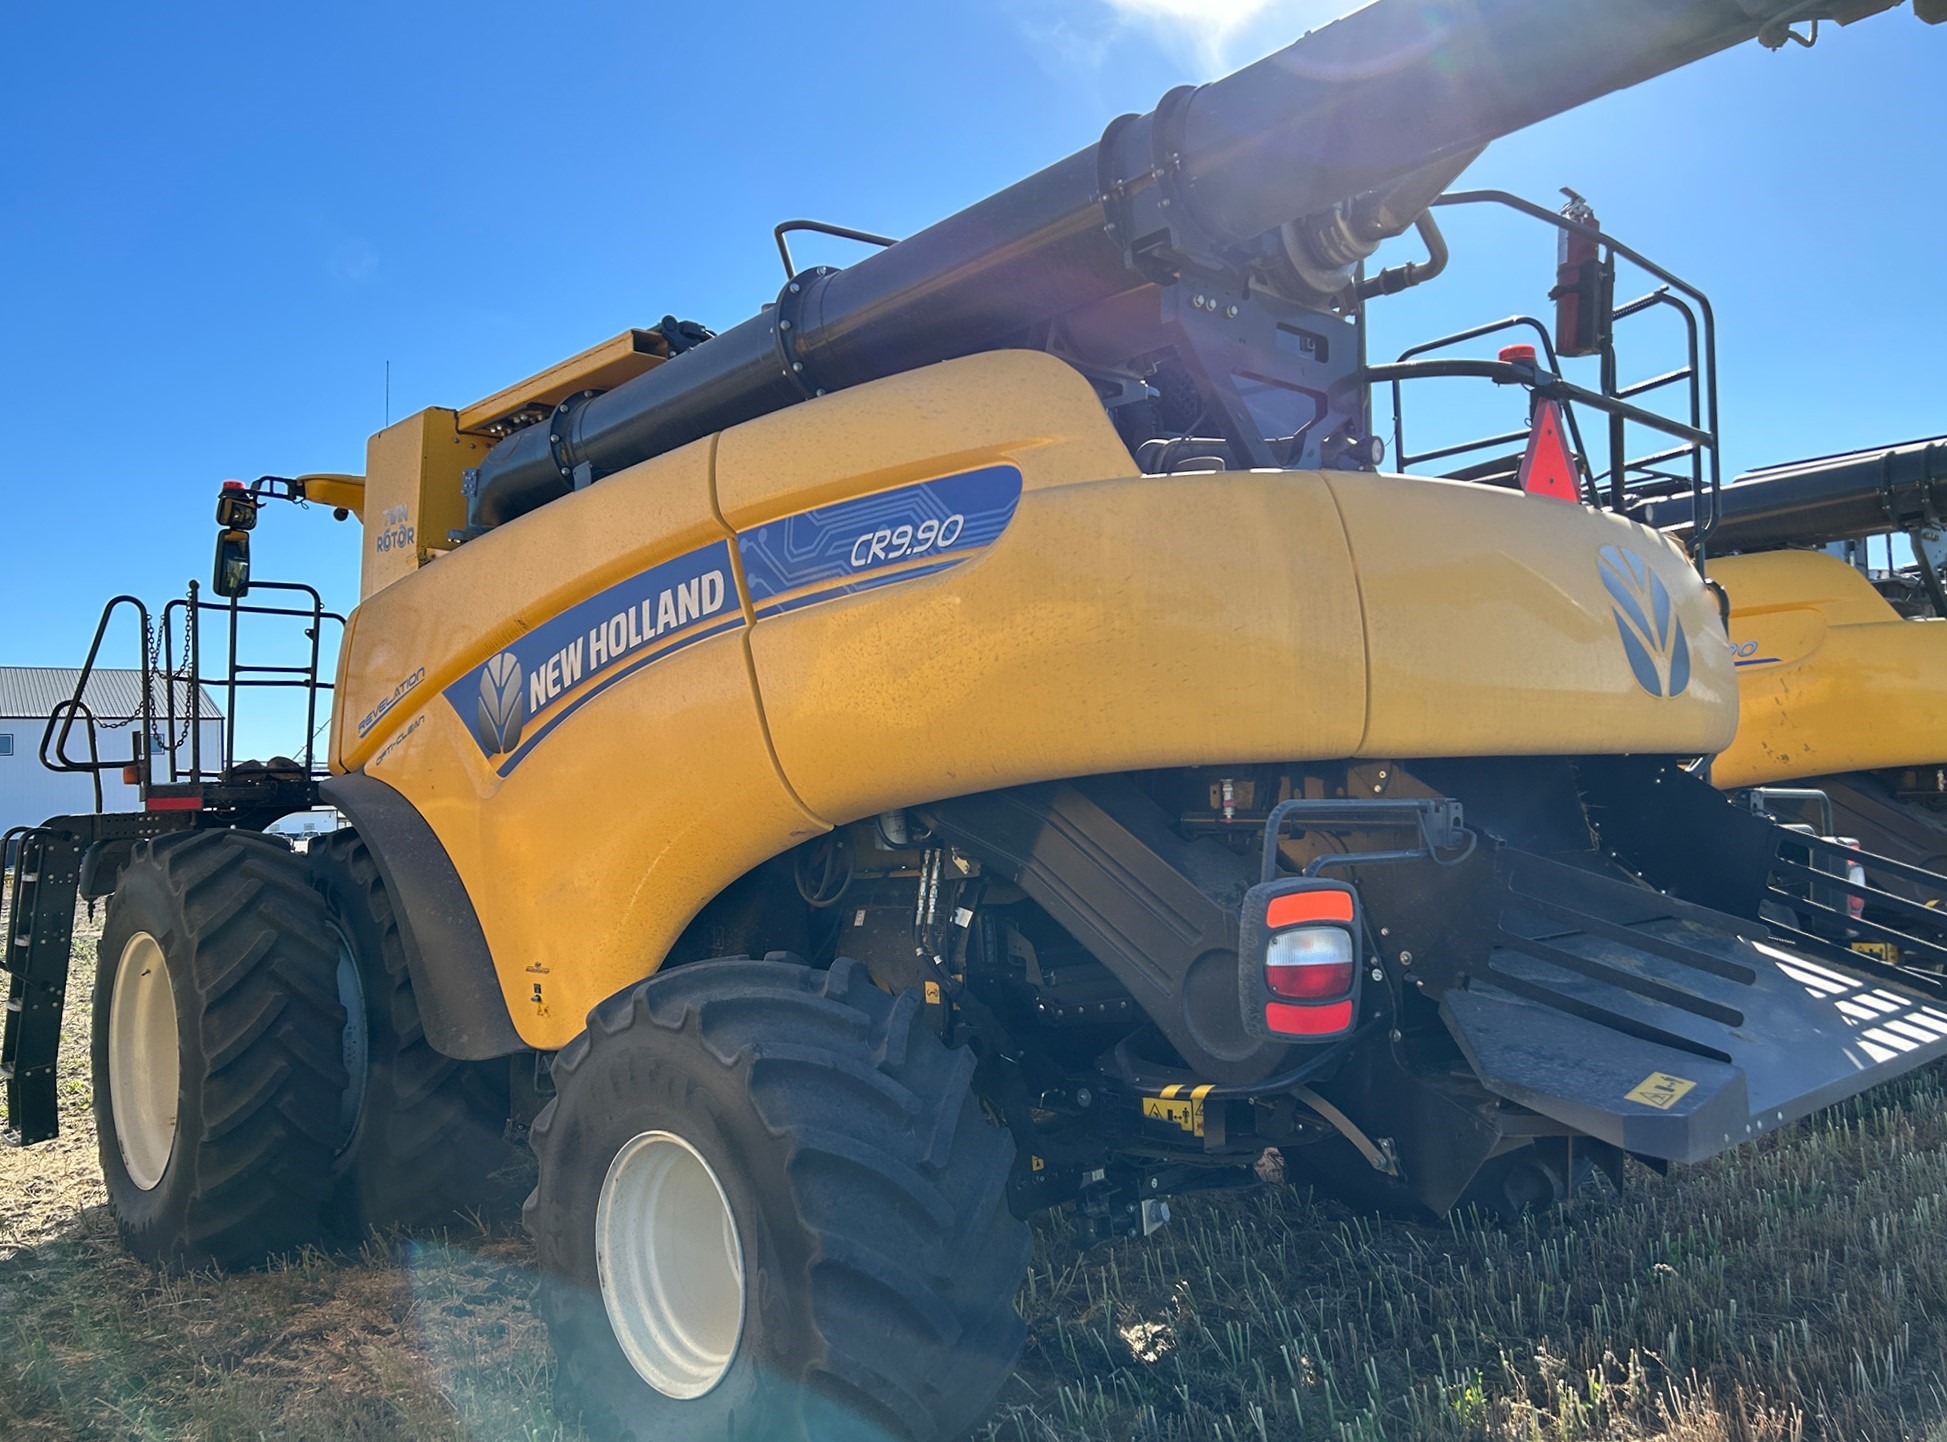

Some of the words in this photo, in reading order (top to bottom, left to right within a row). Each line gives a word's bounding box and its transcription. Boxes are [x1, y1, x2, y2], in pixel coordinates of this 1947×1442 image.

[376, 524, 415, 553] ROTOR
[850, 513, 965, 567] CR9.90
[530, 636, 583, 714] NEW
[589, 569, 724, 671] HOLLAND
[358, 667, 425, 732] REVELATION
